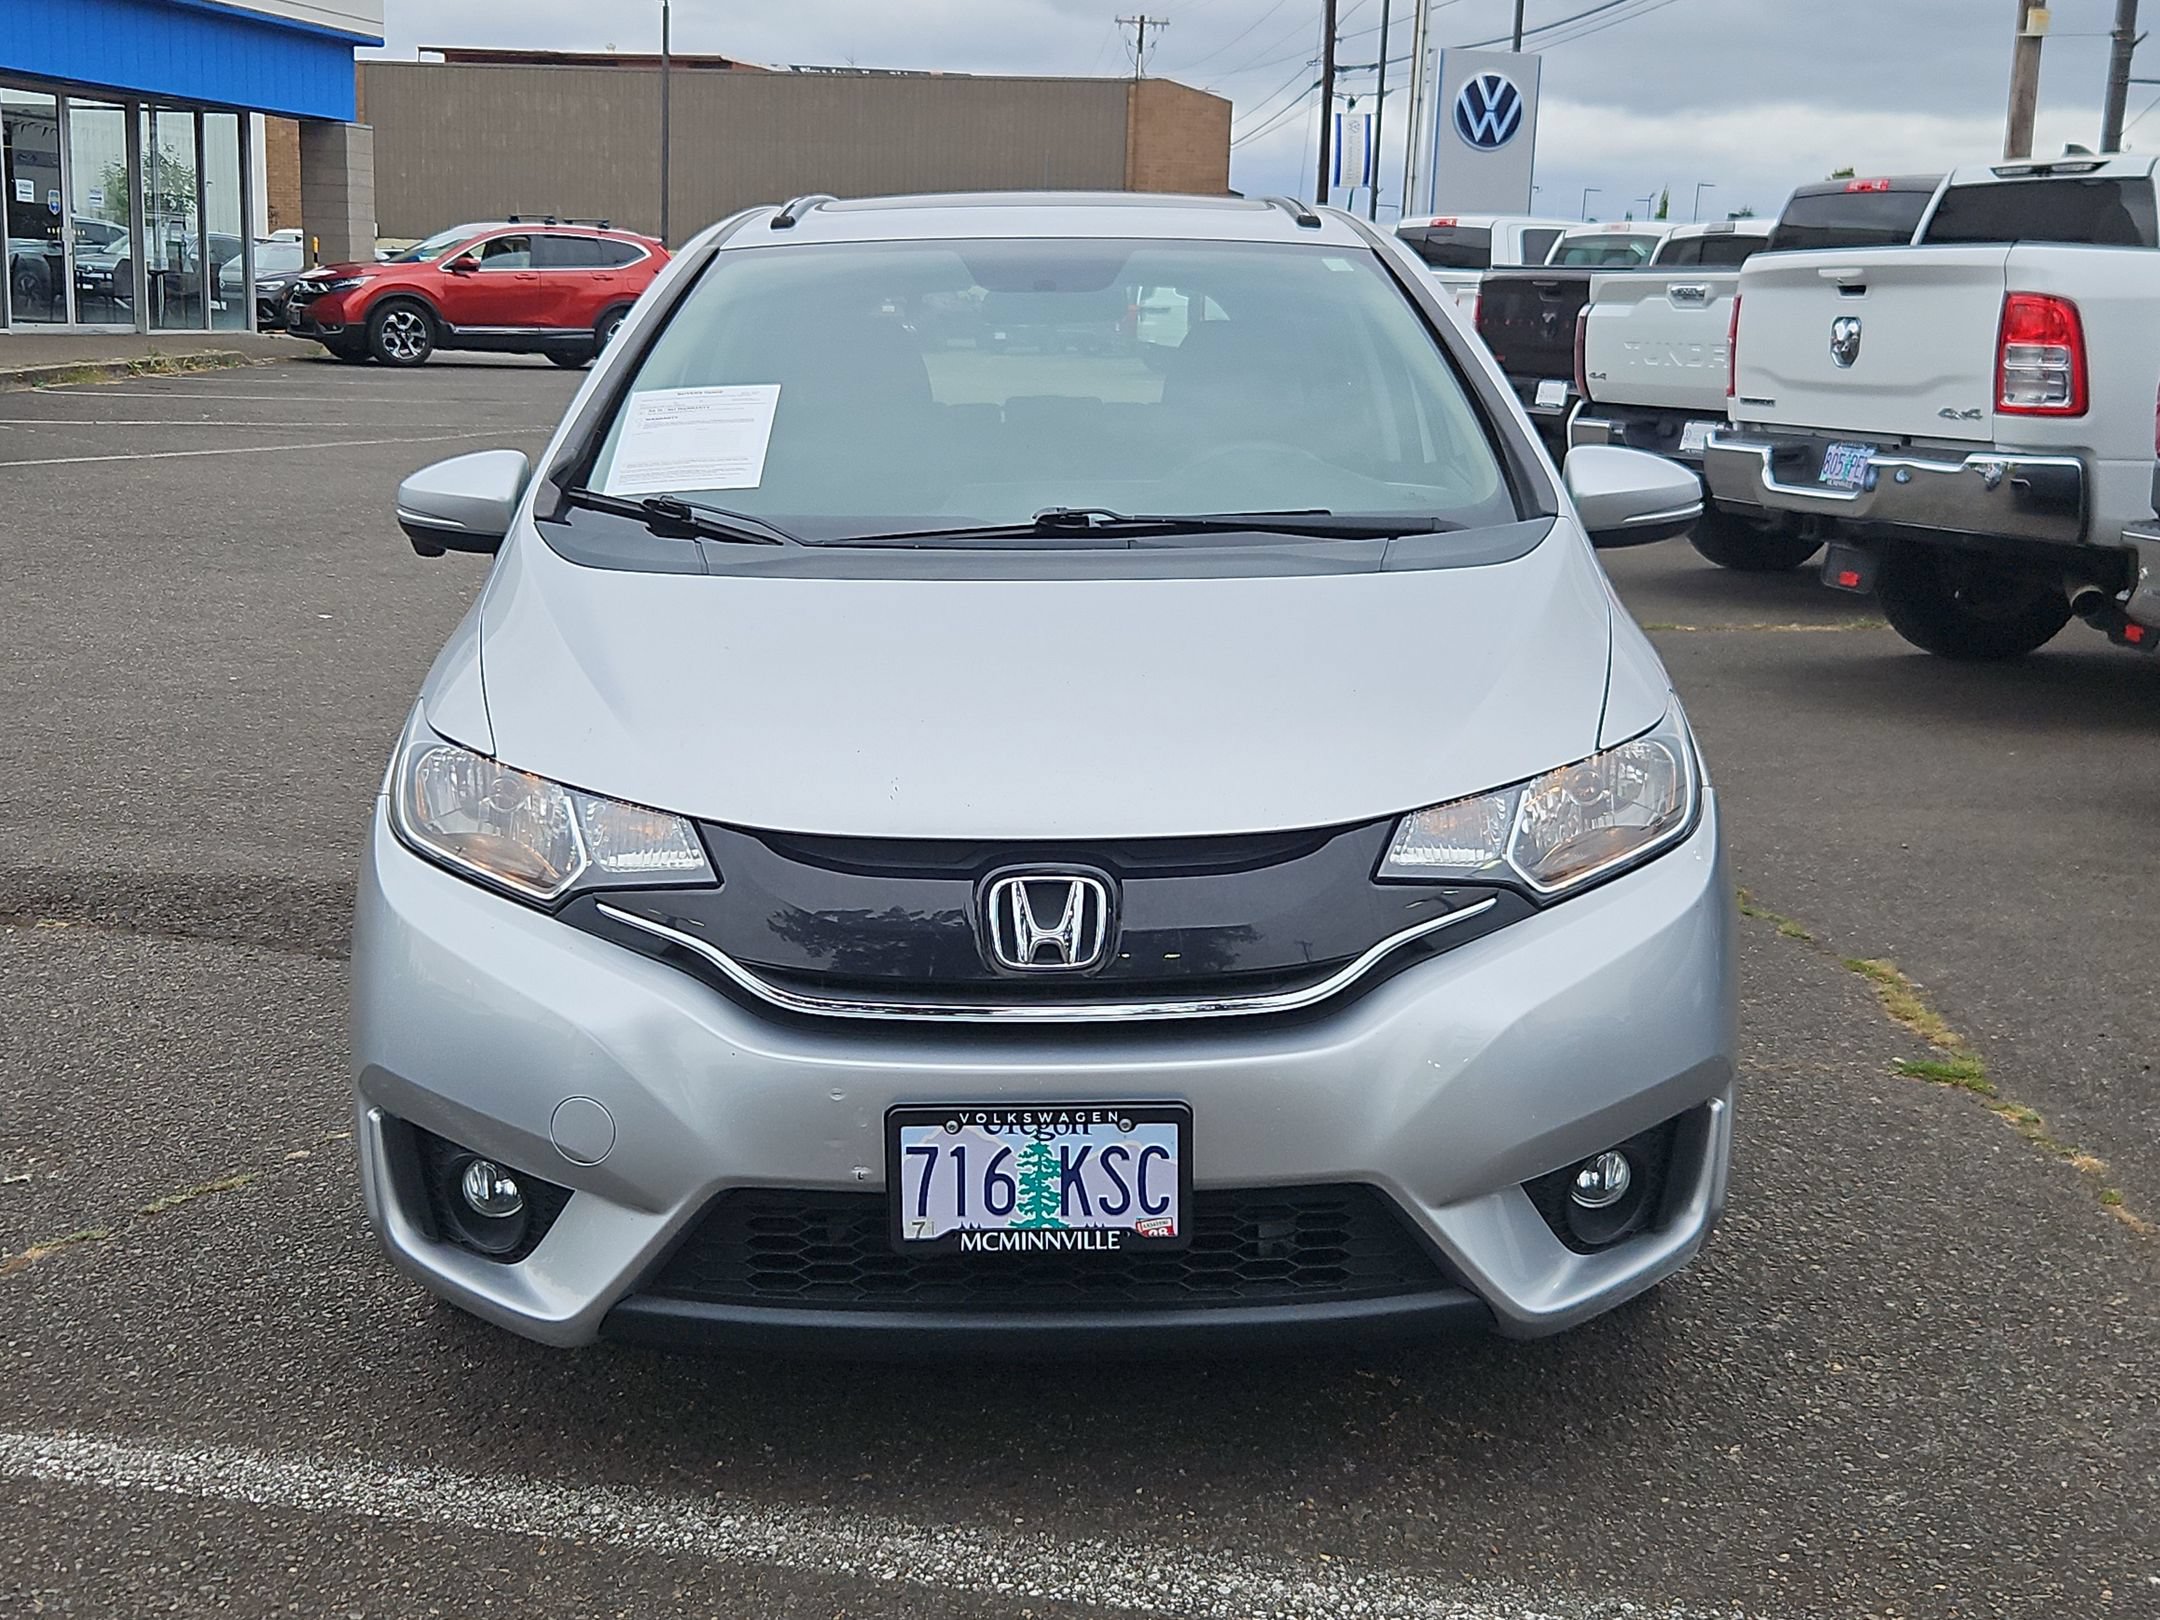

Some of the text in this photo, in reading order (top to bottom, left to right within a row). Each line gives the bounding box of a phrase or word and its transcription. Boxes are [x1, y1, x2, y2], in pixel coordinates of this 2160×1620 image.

[1624, 341, 1730, 369] TUNDR
[959, 1111, 1119, 1124] VOLKSWAGEN
[905, 1145, 1170, 1217] 716 KSC
[960, 1230, 1121, 1251] MCMINNVILLE
